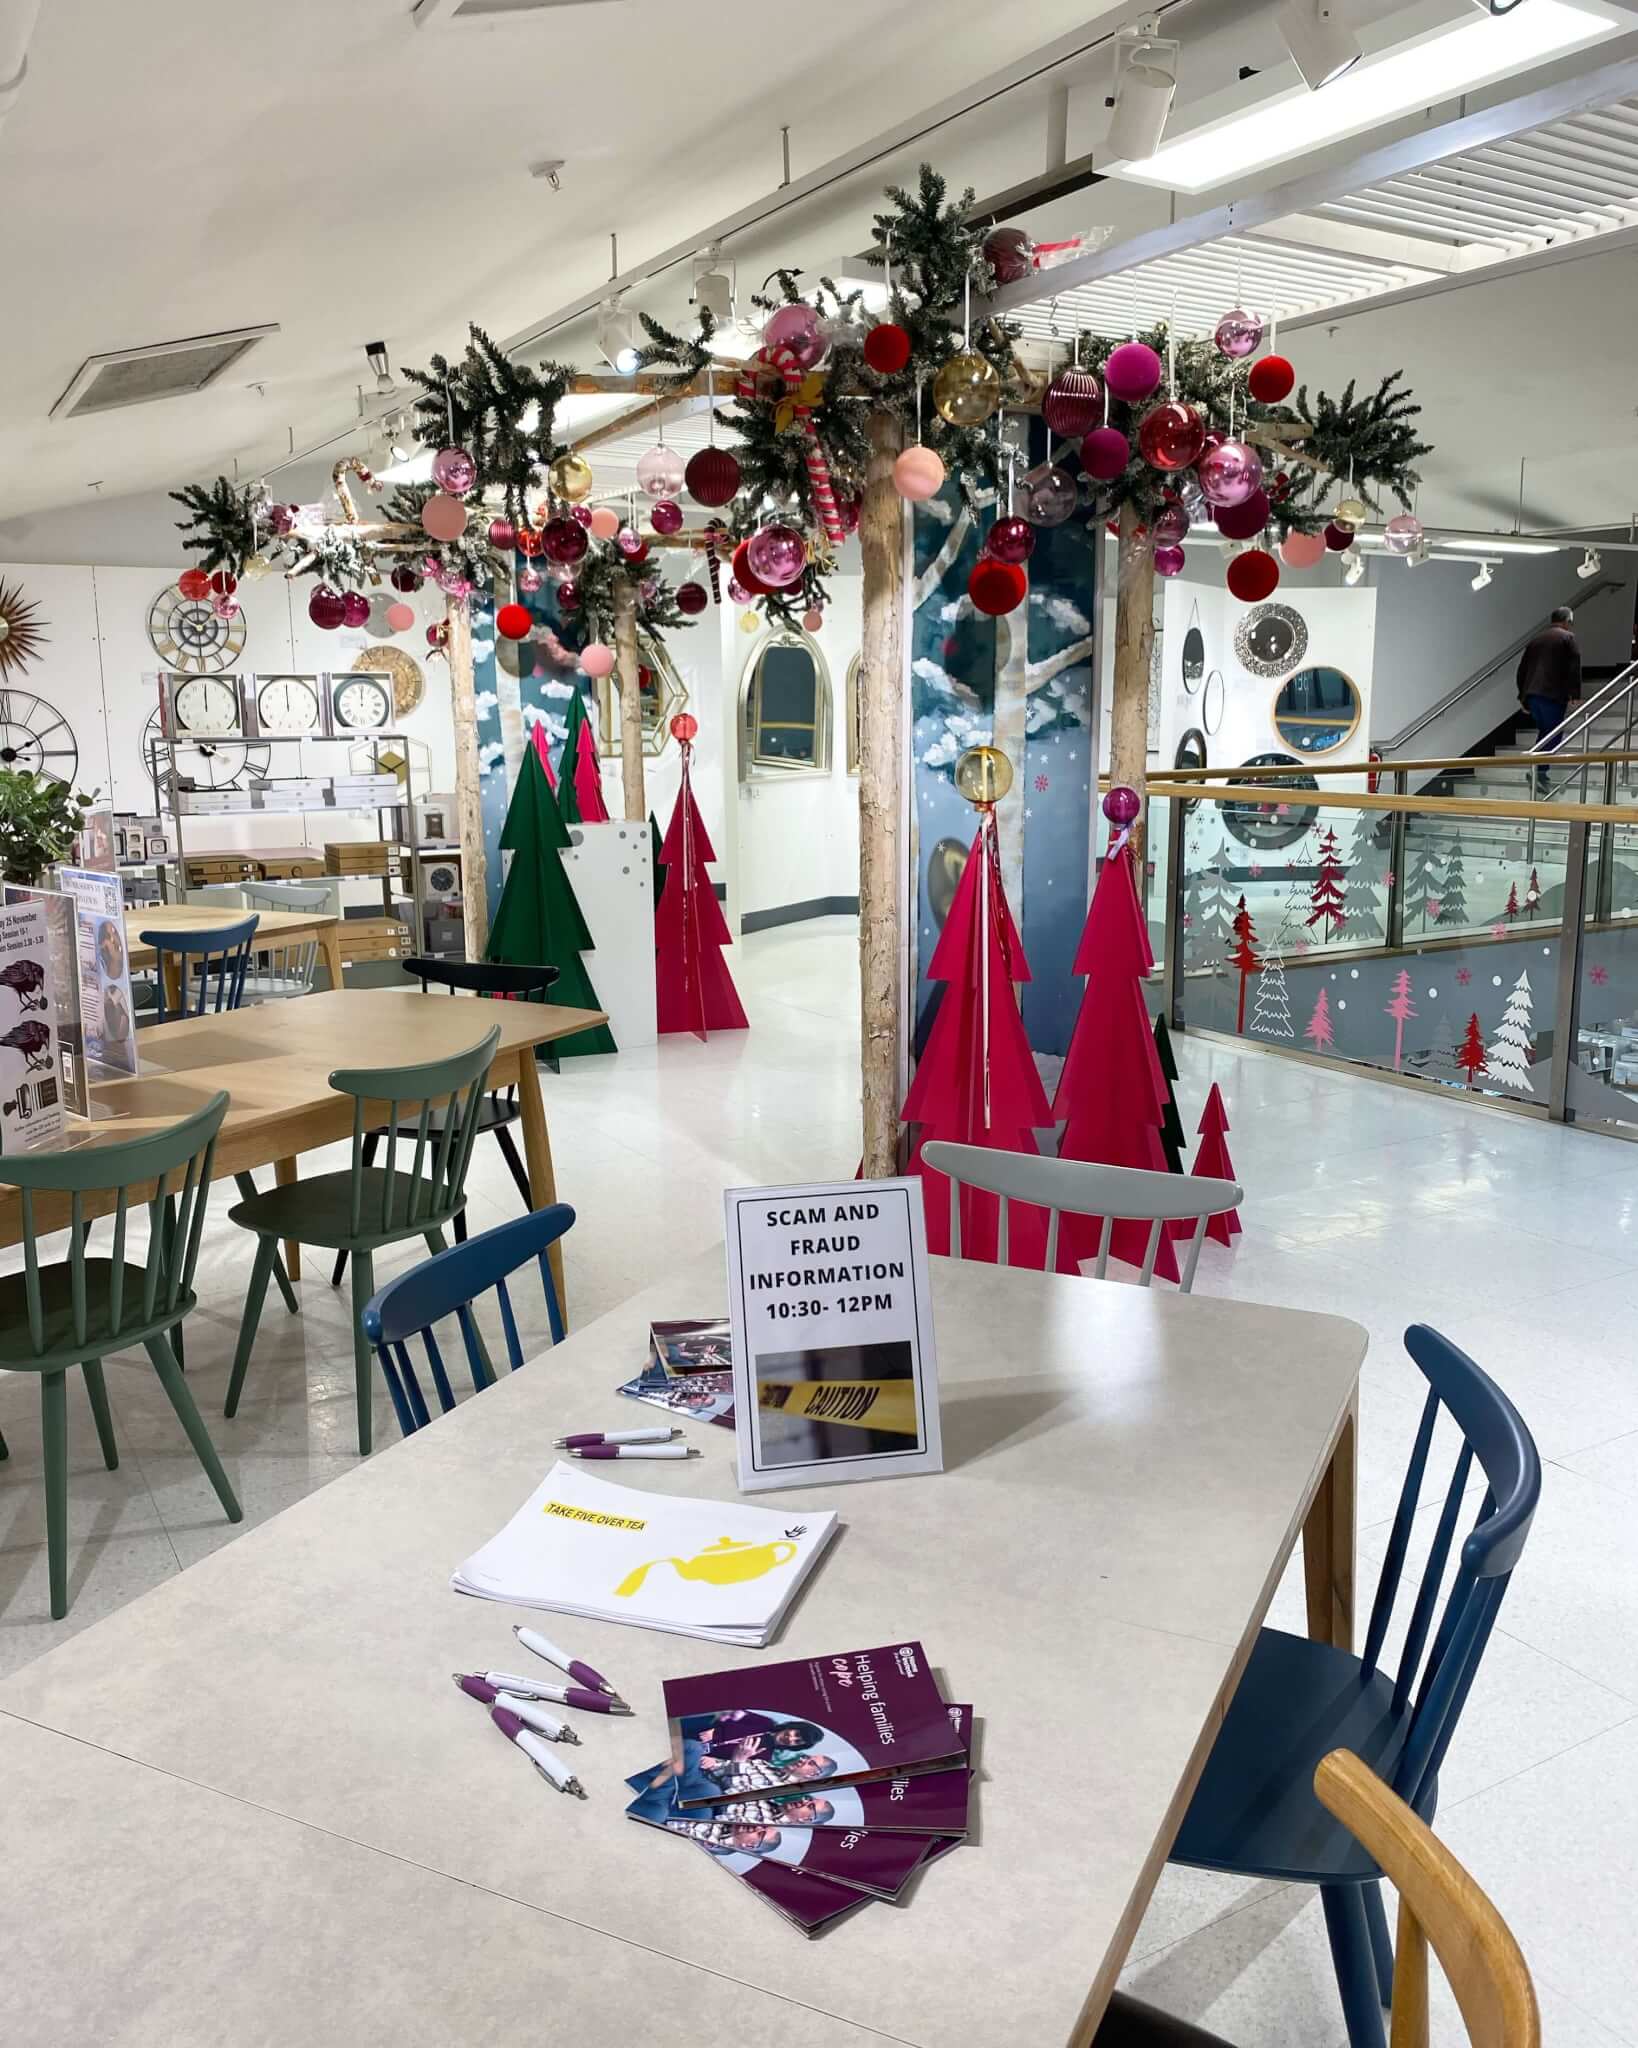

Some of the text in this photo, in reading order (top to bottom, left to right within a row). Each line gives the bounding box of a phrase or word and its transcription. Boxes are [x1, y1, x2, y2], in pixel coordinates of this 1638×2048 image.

[13, 912, 37, 924] November
[767, 1204, 879, 1227] SCAM AND
[790, 1235, 861, 1255] FRAUD
[750, 1262, 904, 1289] INFORMATION
[766, 1293, 892, 1319] 10:30- 12PM
[804, 1385, 880, 1421] CAUTION
[547, 1503, 646, 1531] TAKE FIVE OVER TEA
[828, 1658, 854, 1688] cope
[854, 1654, 896, 1745] Helping families
